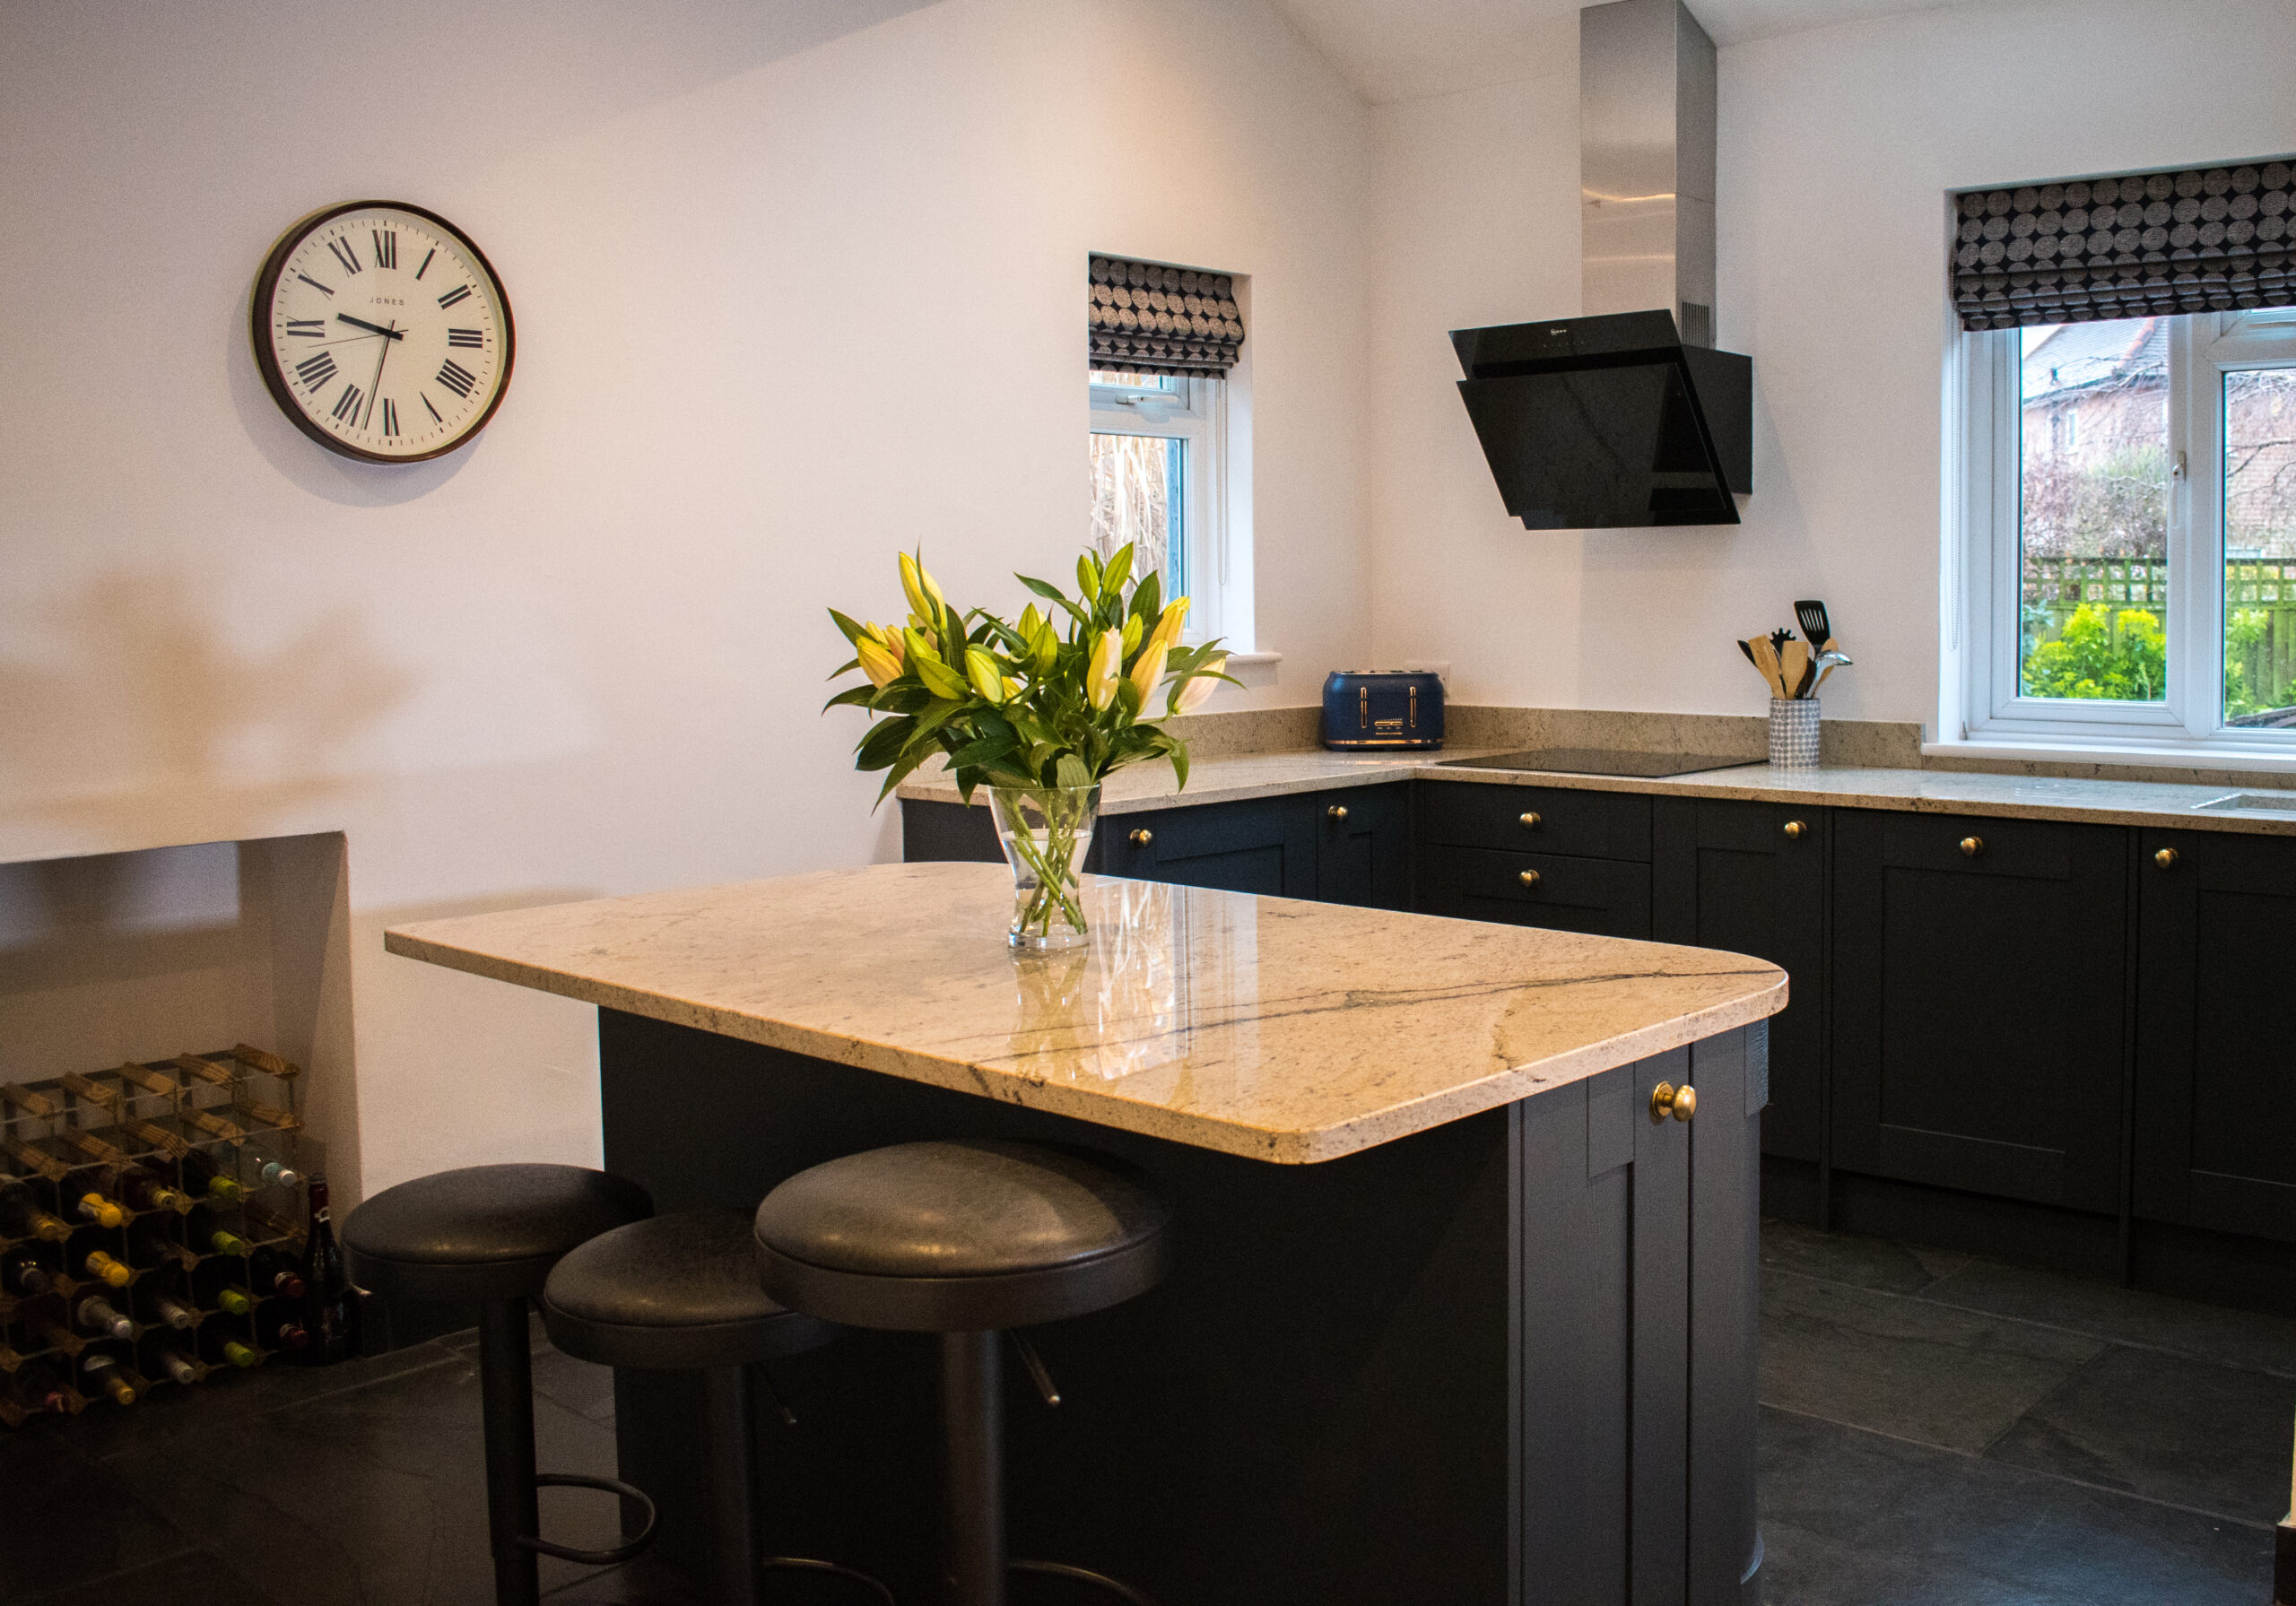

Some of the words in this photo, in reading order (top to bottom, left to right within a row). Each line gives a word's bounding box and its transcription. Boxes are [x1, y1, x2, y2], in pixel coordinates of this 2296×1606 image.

[327, 236, 362, 278] XI
[372, 230, 396, 269] XII
[416, 247, 436, 281] I
[298, 269, 335, 300] X
[370, 297, 404, 306] JONES
[438, 284, 472, 309] II
[286, 316, 326, 338] IX
[448, 328, 483, 349] III
[296, 351, 339, 394] VIII
[332, 384, 365, 427] VII
[383, 398, 400, 436] VI
[420, 391, 443, 426] V
